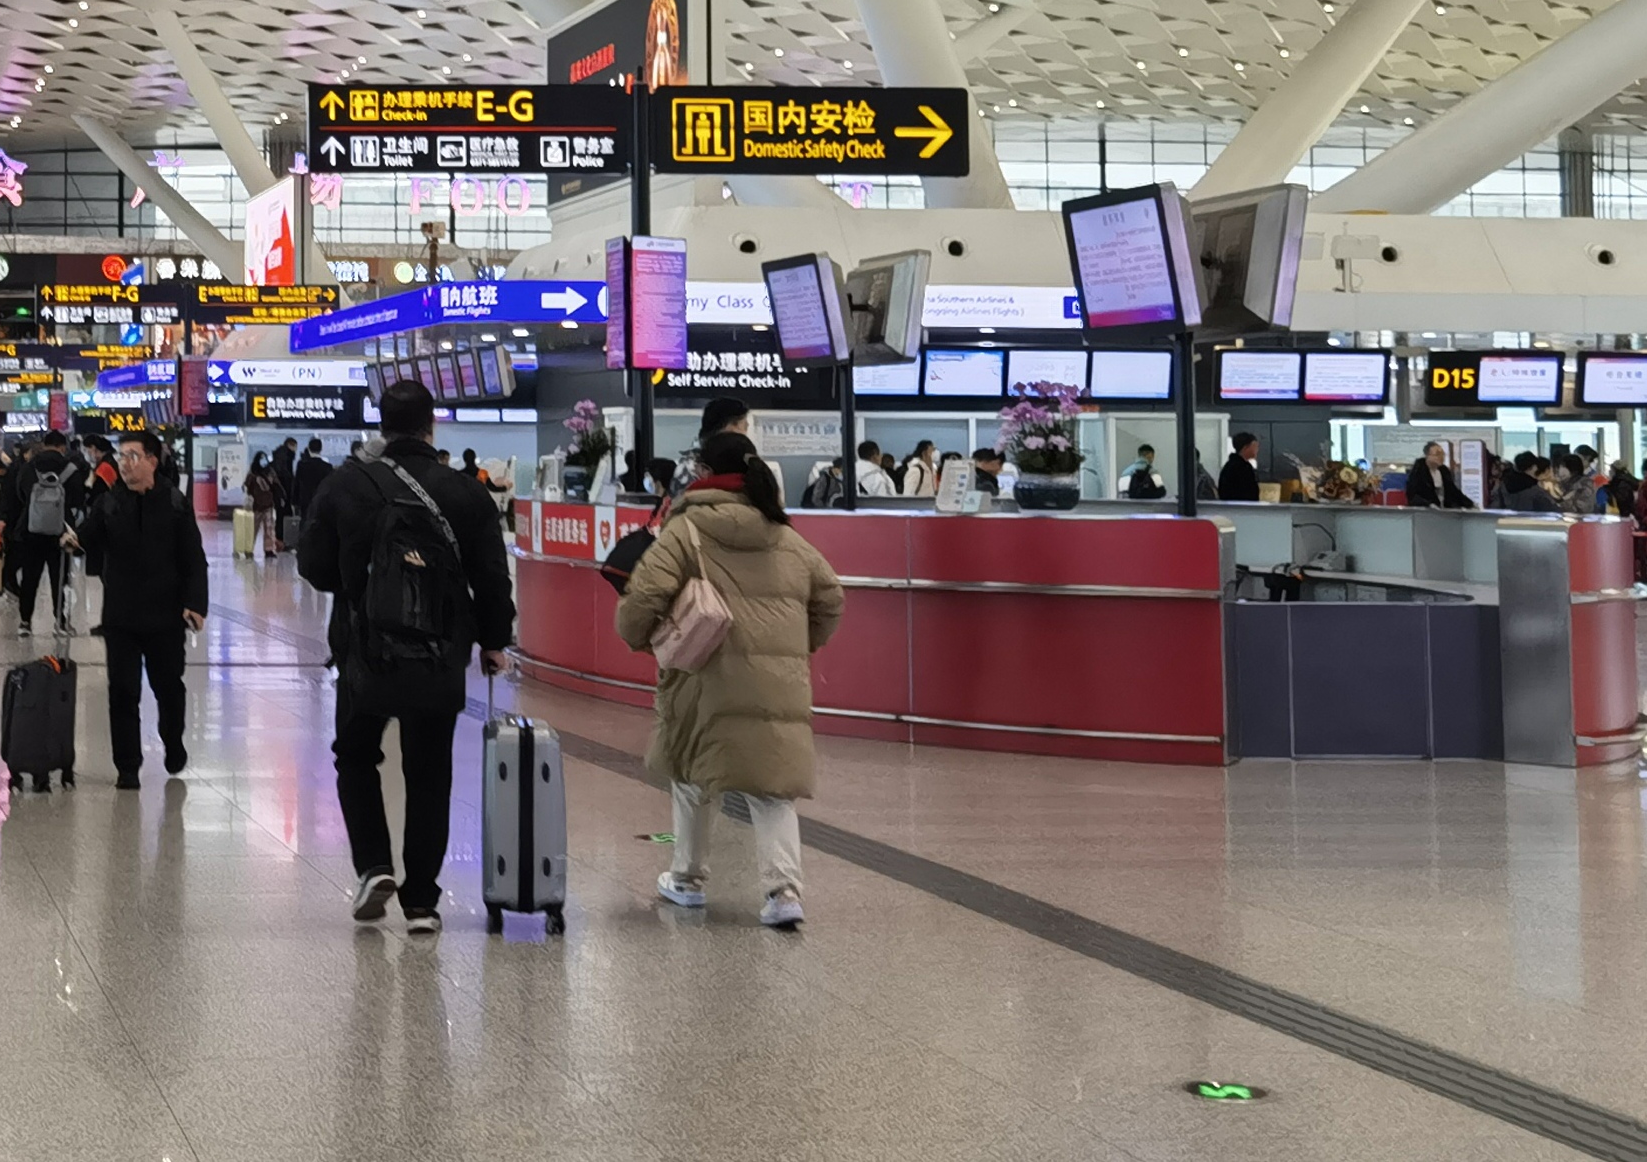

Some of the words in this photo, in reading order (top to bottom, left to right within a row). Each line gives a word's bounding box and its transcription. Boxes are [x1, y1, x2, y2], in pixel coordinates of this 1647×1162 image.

[477, 90, 534, 122] E-G
[743, 100, 876, 134] 国内安检
[743, 139, 804, 159] Domestic
[805, 139, 846, 163] Safety
[847, 139, 886, 159] Check
[409, 173, 531, 216] FOO
[717, 295, 753, 308] Class
[668, 373, 691, 387] Self
[694, 373, 735, 388] Service
[739, 372, 791, 388] Check-in
[1433, 368, 1475, 389] D15
[254, 396, 266, 417] E
